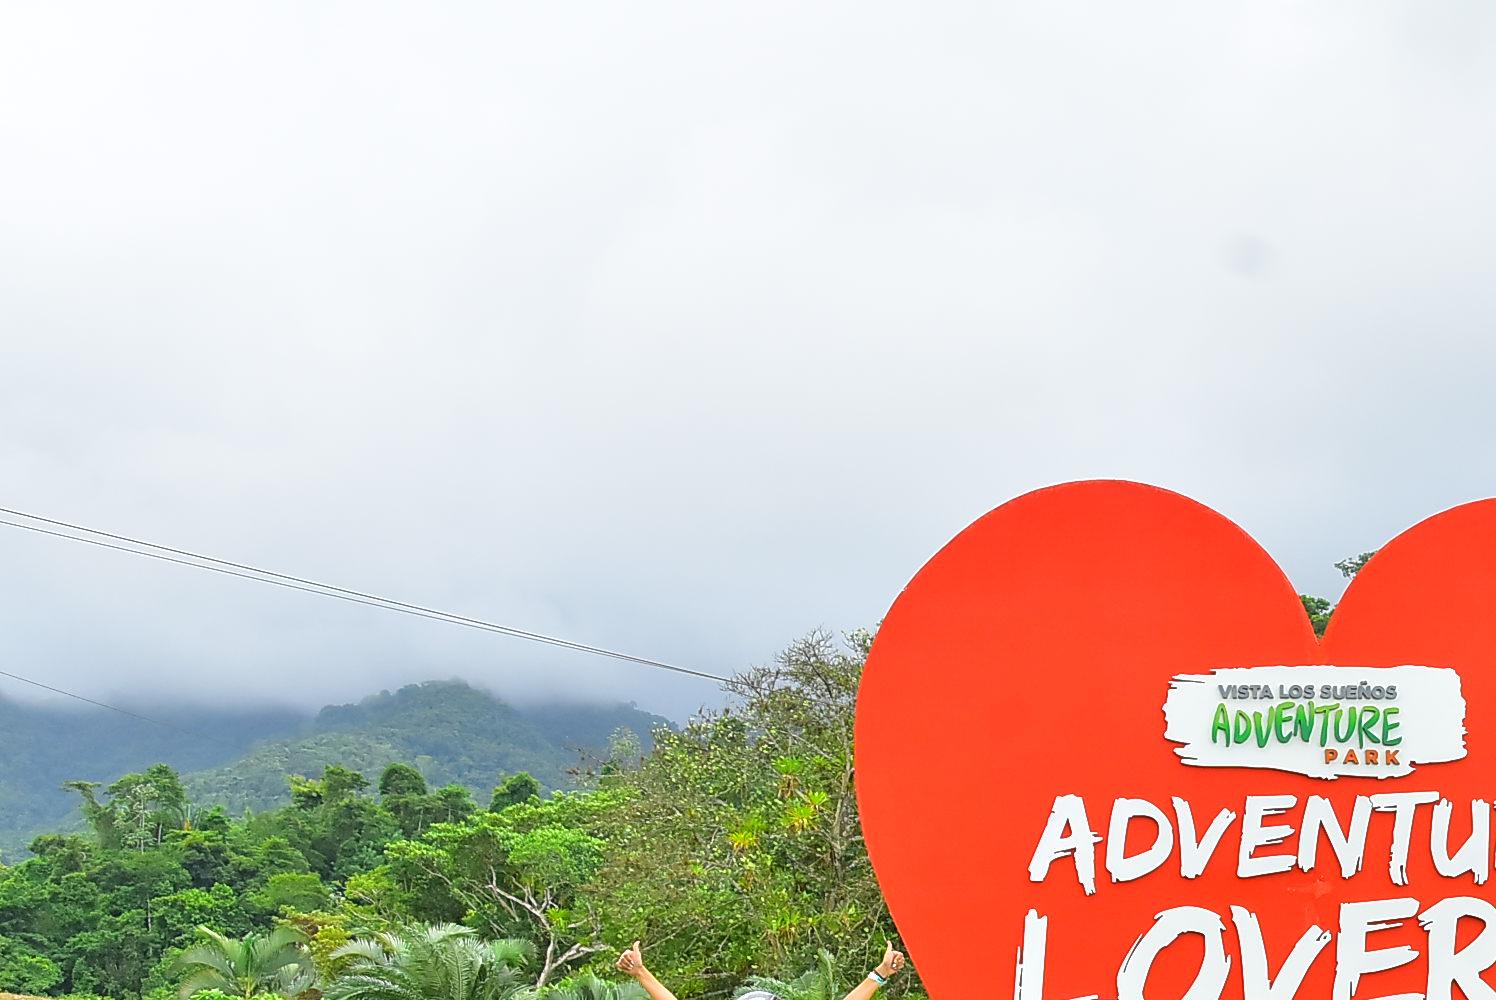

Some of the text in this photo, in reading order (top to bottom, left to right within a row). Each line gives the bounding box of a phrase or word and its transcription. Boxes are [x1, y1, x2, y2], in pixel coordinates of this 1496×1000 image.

[1218, 680, 1398, 700] VISTA LOS SUEÑOS
[1211, 700, 1403, 749] ADVENTURE
[1324, 748, 1401, 766] PARK
